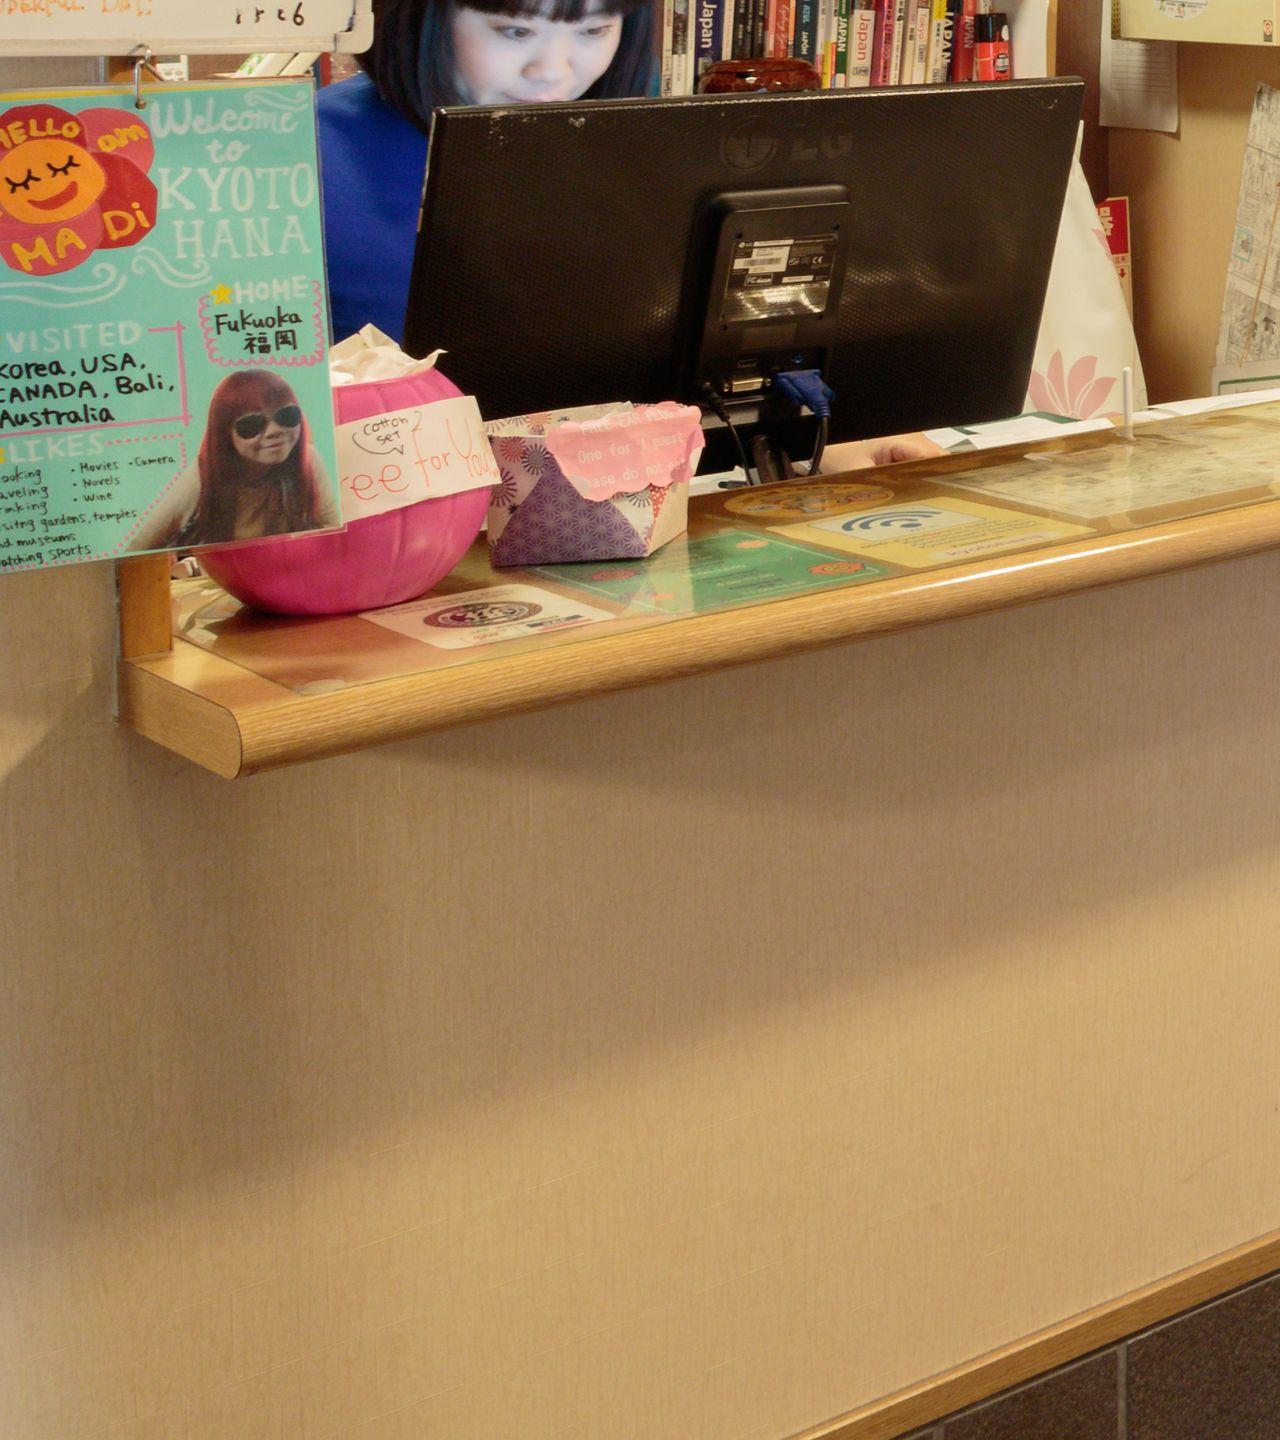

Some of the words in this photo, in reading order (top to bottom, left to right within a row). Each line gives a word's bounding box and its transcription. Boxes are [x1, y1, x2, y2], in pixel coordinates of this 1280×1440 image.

[699, 0, 718, 50] Japan
[837, 16, 848, 53] JAPAN
[857, 13, 872, 62] Japan
[941, 11, 955, 64] JAPAN
[963, 15, 974, 49] JAPAN
[151, 96, 298, 140] Welcome
[97, 124, 149, 153] am
[206, 138, 252, 164] to
[157, 162, 315, 213] KYOTO
[172, 214, 313, 261] HANA
[233, 274, 308, 305] HOME
[6, 320, 142, 354] VISITED
[243, 329, 299, 355] 福岡
[81, 352, 146, 375] USA,
[115, 372, 175, 395] Bali,
[0, 404, 116, 430] Australia
[8, 432, 104, 463] LIKES
[577, 449, 603, 464] One
[609, 442, 633, 457] for
[0, 465, 42, 485] ooking
[79, 460, 119, 474] Movies
[134, 454, 176, 467] Camera
[341, 464, 411, 501] ee
[590, 474, 616, 488] ase
[0, 486, 49, 500] aveling
[83, 474, 121, 488] Novels
[83, 490, 114, 503] Wine
[93, 507, 138, 525] temples
[17, 532, 77, 548] museums
[0, 549, 44, 568] atching
